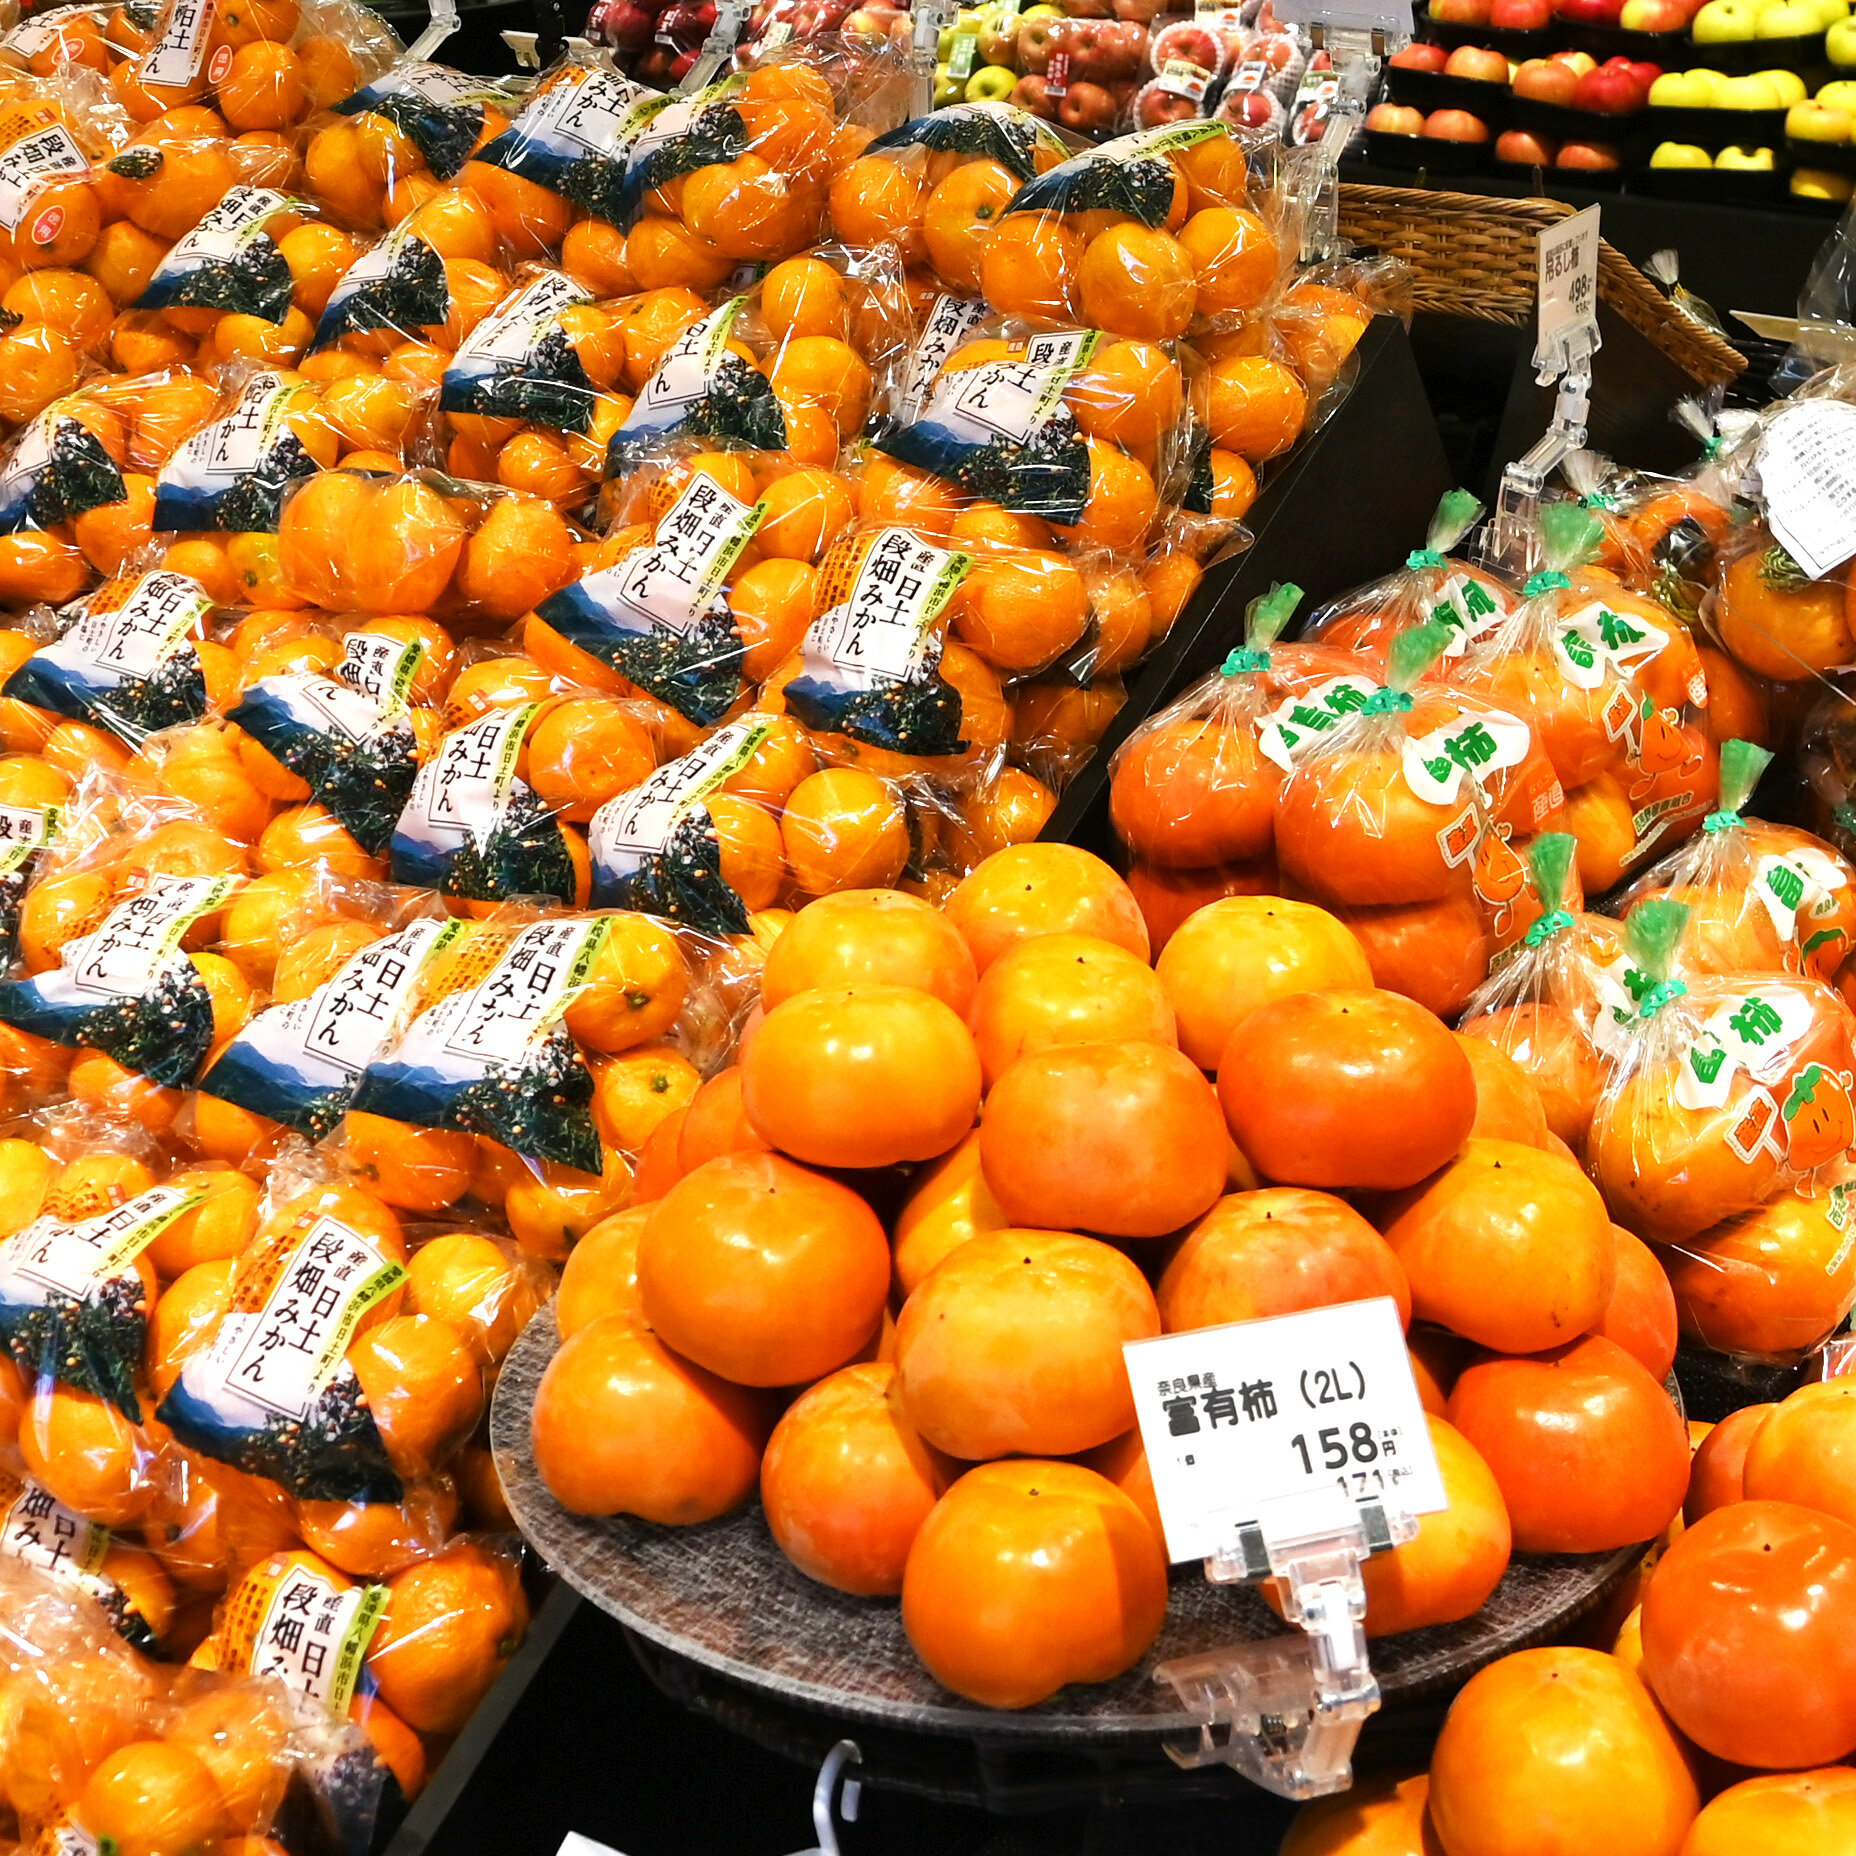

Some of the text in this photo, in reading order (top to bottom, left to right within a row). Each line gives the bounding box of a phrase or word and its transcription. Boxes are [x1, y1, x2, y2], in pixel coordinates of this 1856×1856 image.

[844, 532, 911, 660] 段畑みかん
[332, 1248, 367, 1280] 産直
[238, 1234, 340, 1383] 段畑みかん
[287, 1283, 337, 1353] 日土
[1158, 1373, 1217, 1397] 奈良県産
[1163, 1381, 1277, 1437] 富有柿
